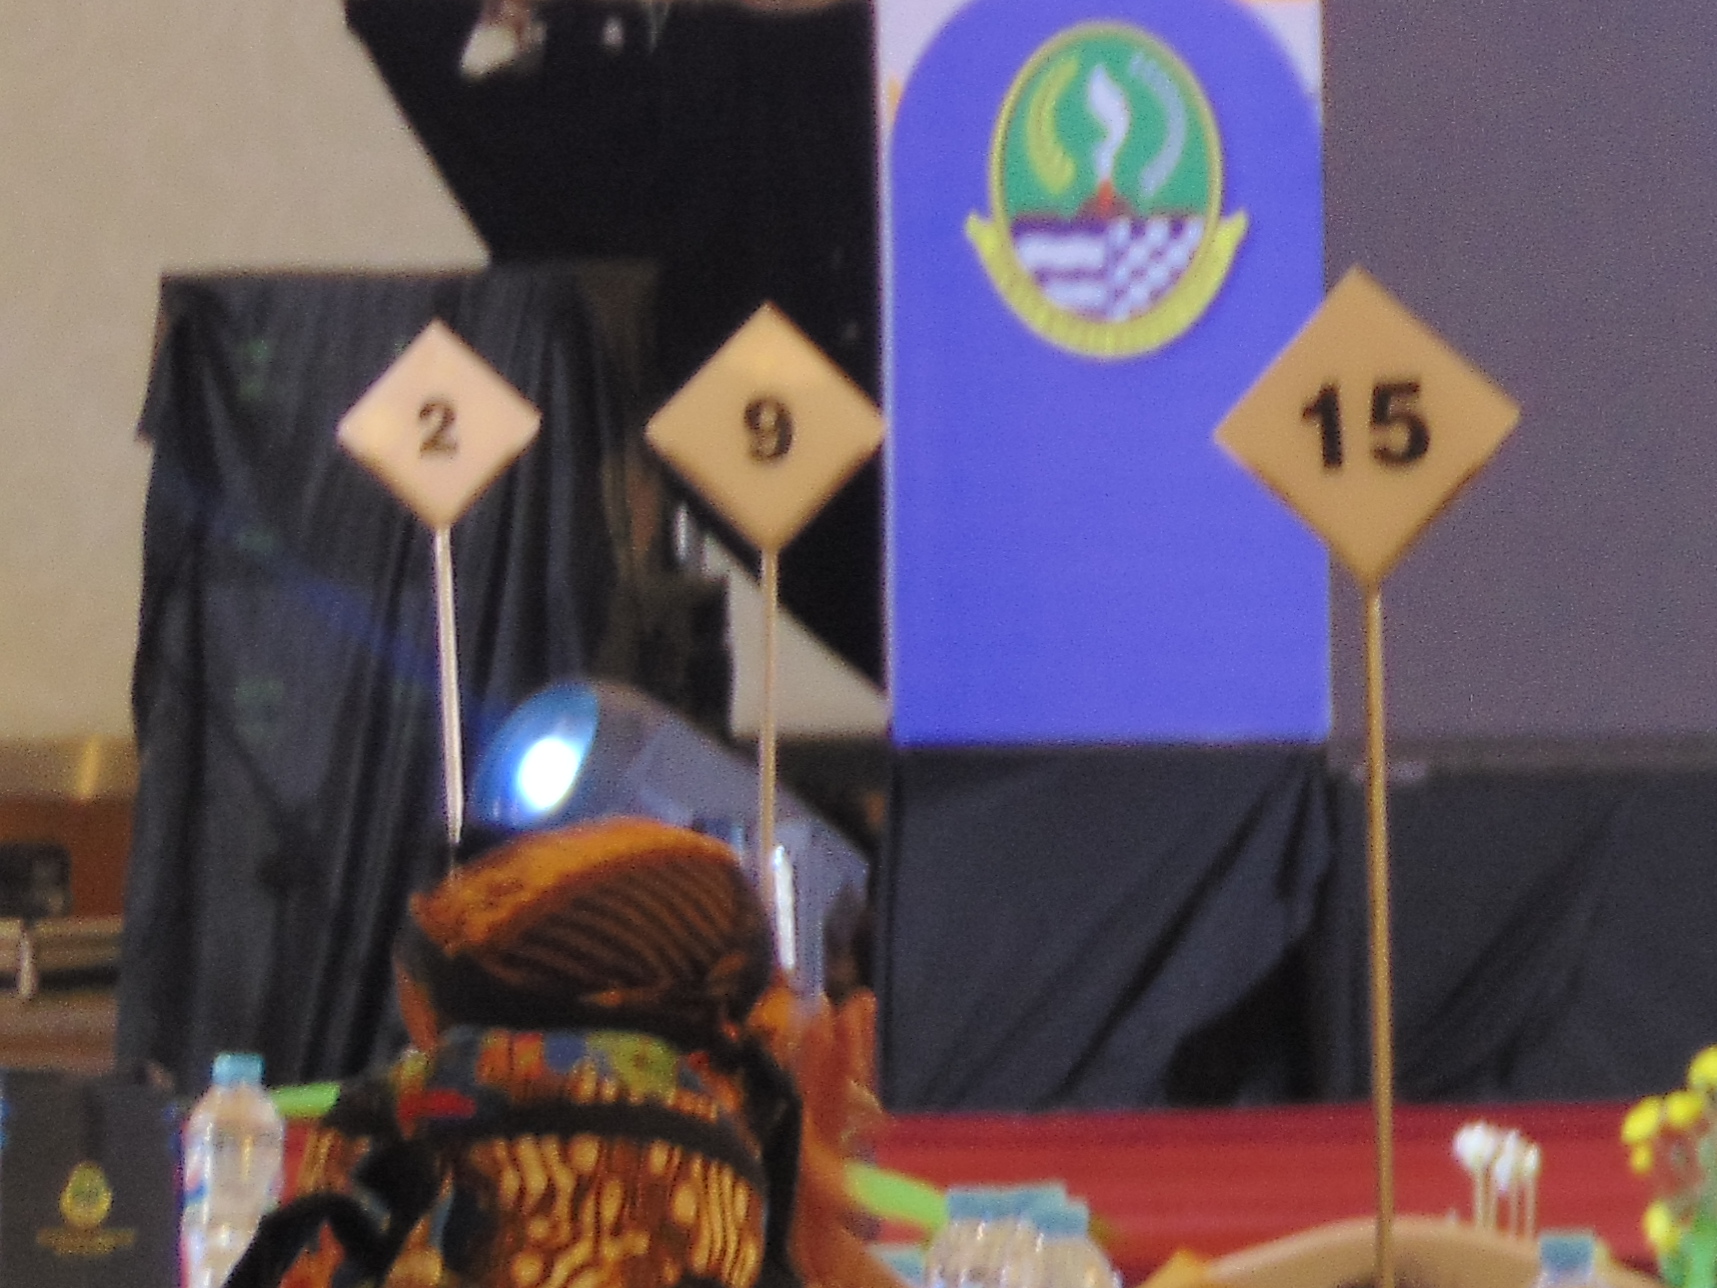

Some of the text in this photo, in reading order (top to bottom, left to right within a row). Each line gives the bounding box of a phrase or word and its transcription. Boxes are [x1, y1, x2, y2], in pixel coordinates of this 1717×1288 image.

[418, 397, 457, 458] 2
[741, 396, 796, 464] 9
[1302, 375, 1432, 470] 15
